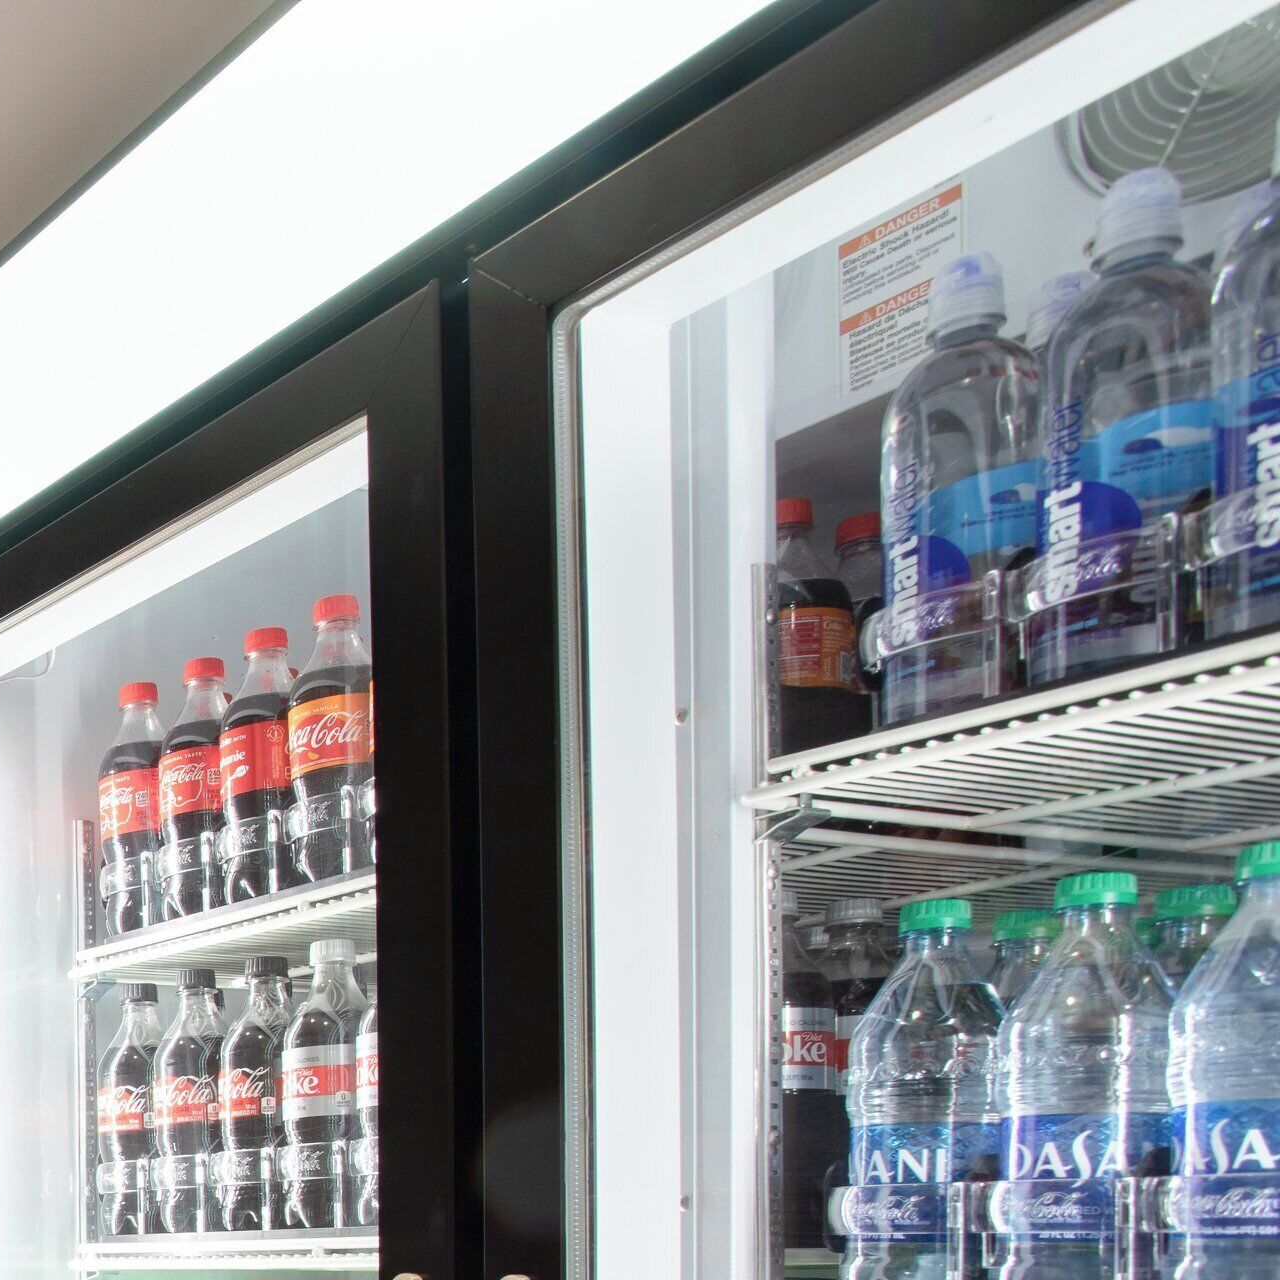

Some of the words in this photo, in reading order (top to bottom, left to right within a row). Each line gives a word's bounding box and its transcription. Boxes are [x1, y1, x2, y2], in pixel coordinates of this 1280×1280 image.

[874, 198, 940, 240] DANGER
[842, 246, 877, 270] Electric
[880, 230, 909, 251] Shock
[859, 255, 886, 272] Cause
[887, 239, 912, 256] Death
[925, 215, 958, 236] serious
[848, 316, 882, 341] Hasard
[884, 311, 896, 324] de
[848, 333, 886, 358] Blessure
[184, 751, 203, 759] TASTE
[208, 769, 220, 777] 240
[802, 1031, 822, 1042] Diet
[297, 1068, 314, 1077] Diet
